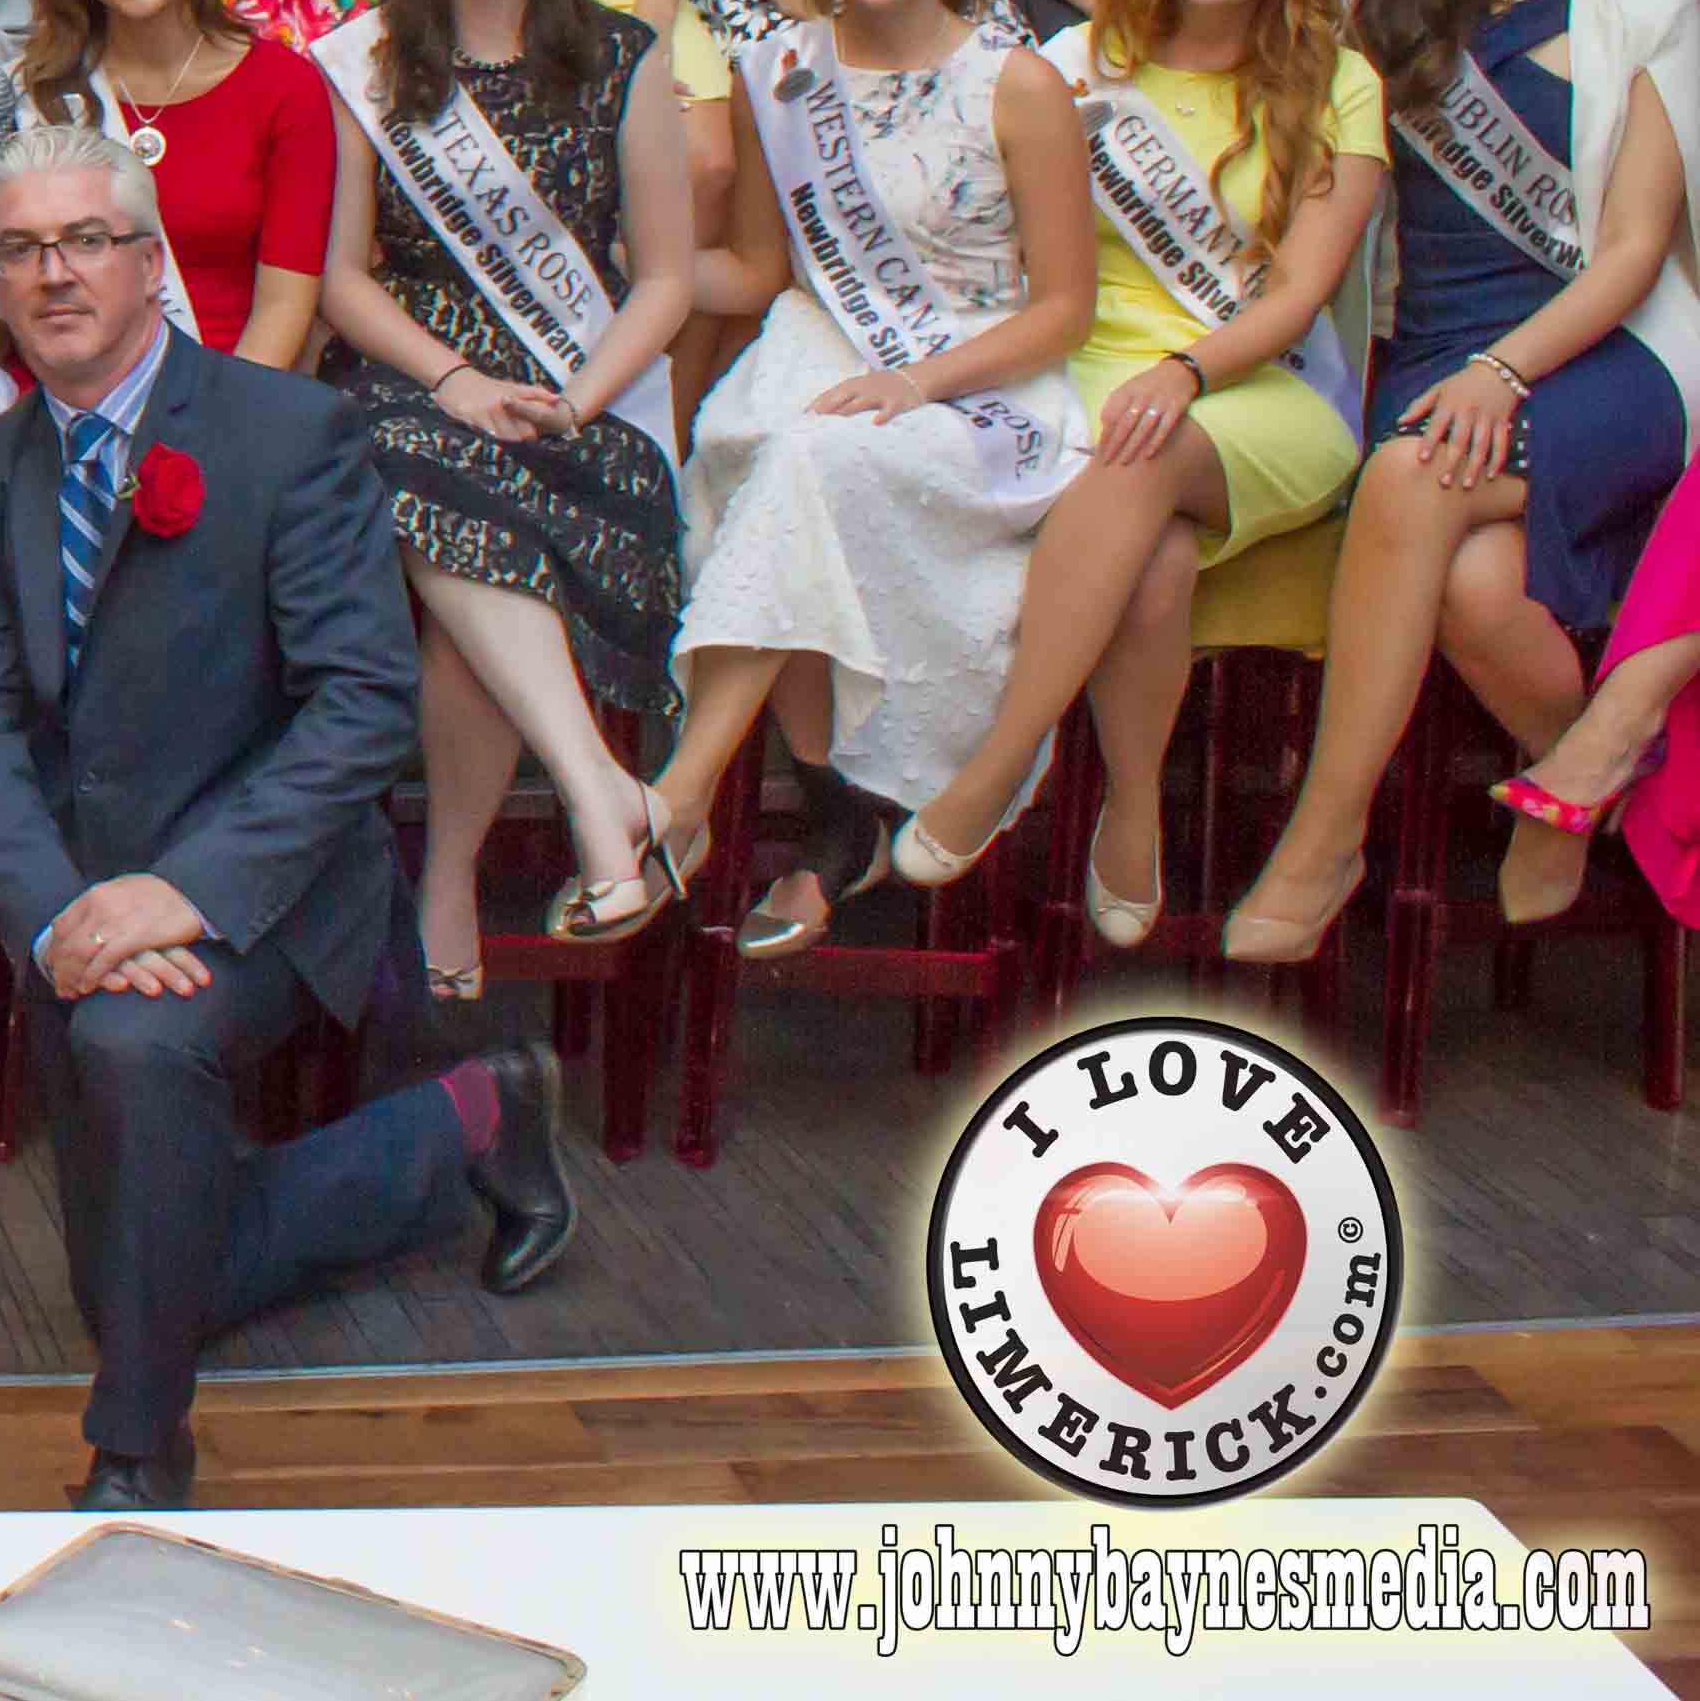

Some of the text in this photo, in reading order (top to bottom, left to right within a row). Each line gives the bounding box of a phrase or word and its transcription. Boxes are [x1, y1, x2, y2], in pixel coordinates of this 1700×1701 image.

[430, 108, 596, 320] TEXAS ROSE
[804, 79, 894, 254] WESTERN
[1112, 115, 1245, 266] GERMANY
[475, 241, 587, 373] Silverware
[789, 180, 880, 328] Newbridge
